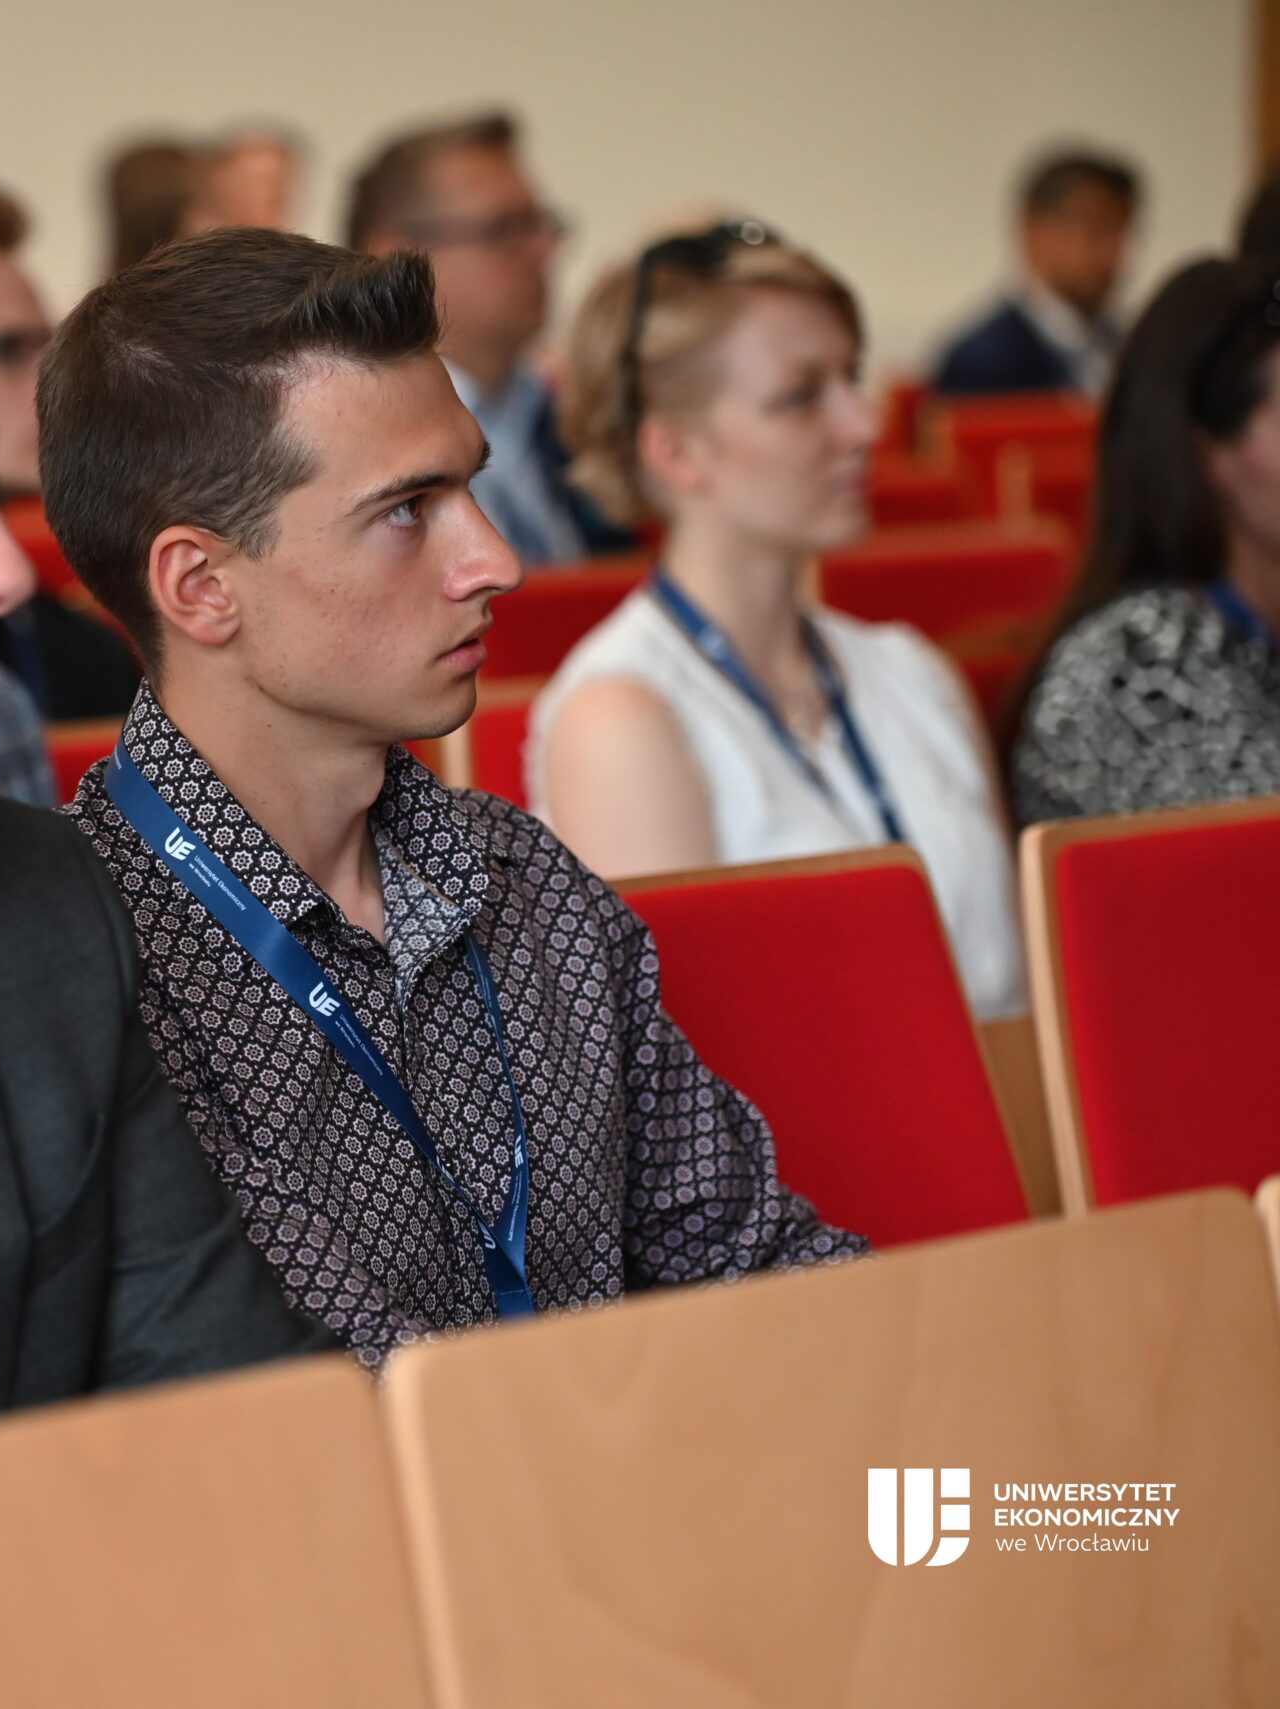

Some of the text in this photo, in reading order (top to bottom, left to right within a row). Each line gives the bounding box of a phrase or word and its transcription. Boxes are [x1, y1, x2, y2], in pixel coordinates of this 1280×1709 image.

[165, 827, 196, 860] UE
[194, 855, 247, 912] Uniwersytet Ekonomiczny
[309, 981, 340, 1017] UE
